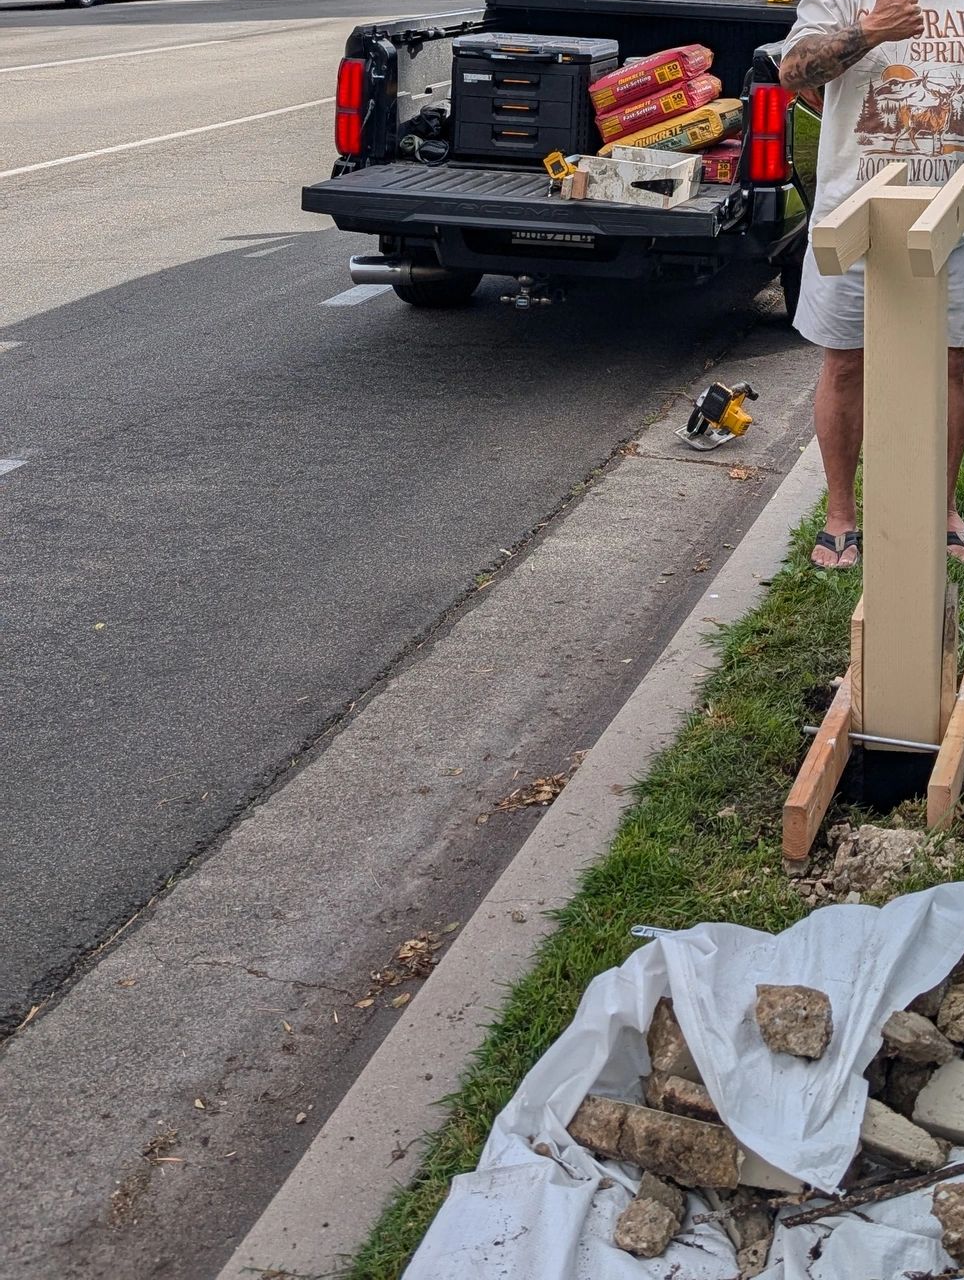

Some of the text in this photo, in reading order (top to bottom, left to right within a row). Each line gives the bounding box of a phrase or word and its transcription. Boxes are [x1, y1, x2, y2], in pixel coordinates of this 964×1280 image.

[667, 63, 678, 73] 50
[616, 74, 652, 93] Fast-Setting
[671, 93, 683, 103] 50
[622, 104, 657, 121] Fast-Setting
[633, 124, 684, 147] QUIKRETE
[856, 157, 907, 182] ROC
[433, 200, 571, 217] TACOMA
